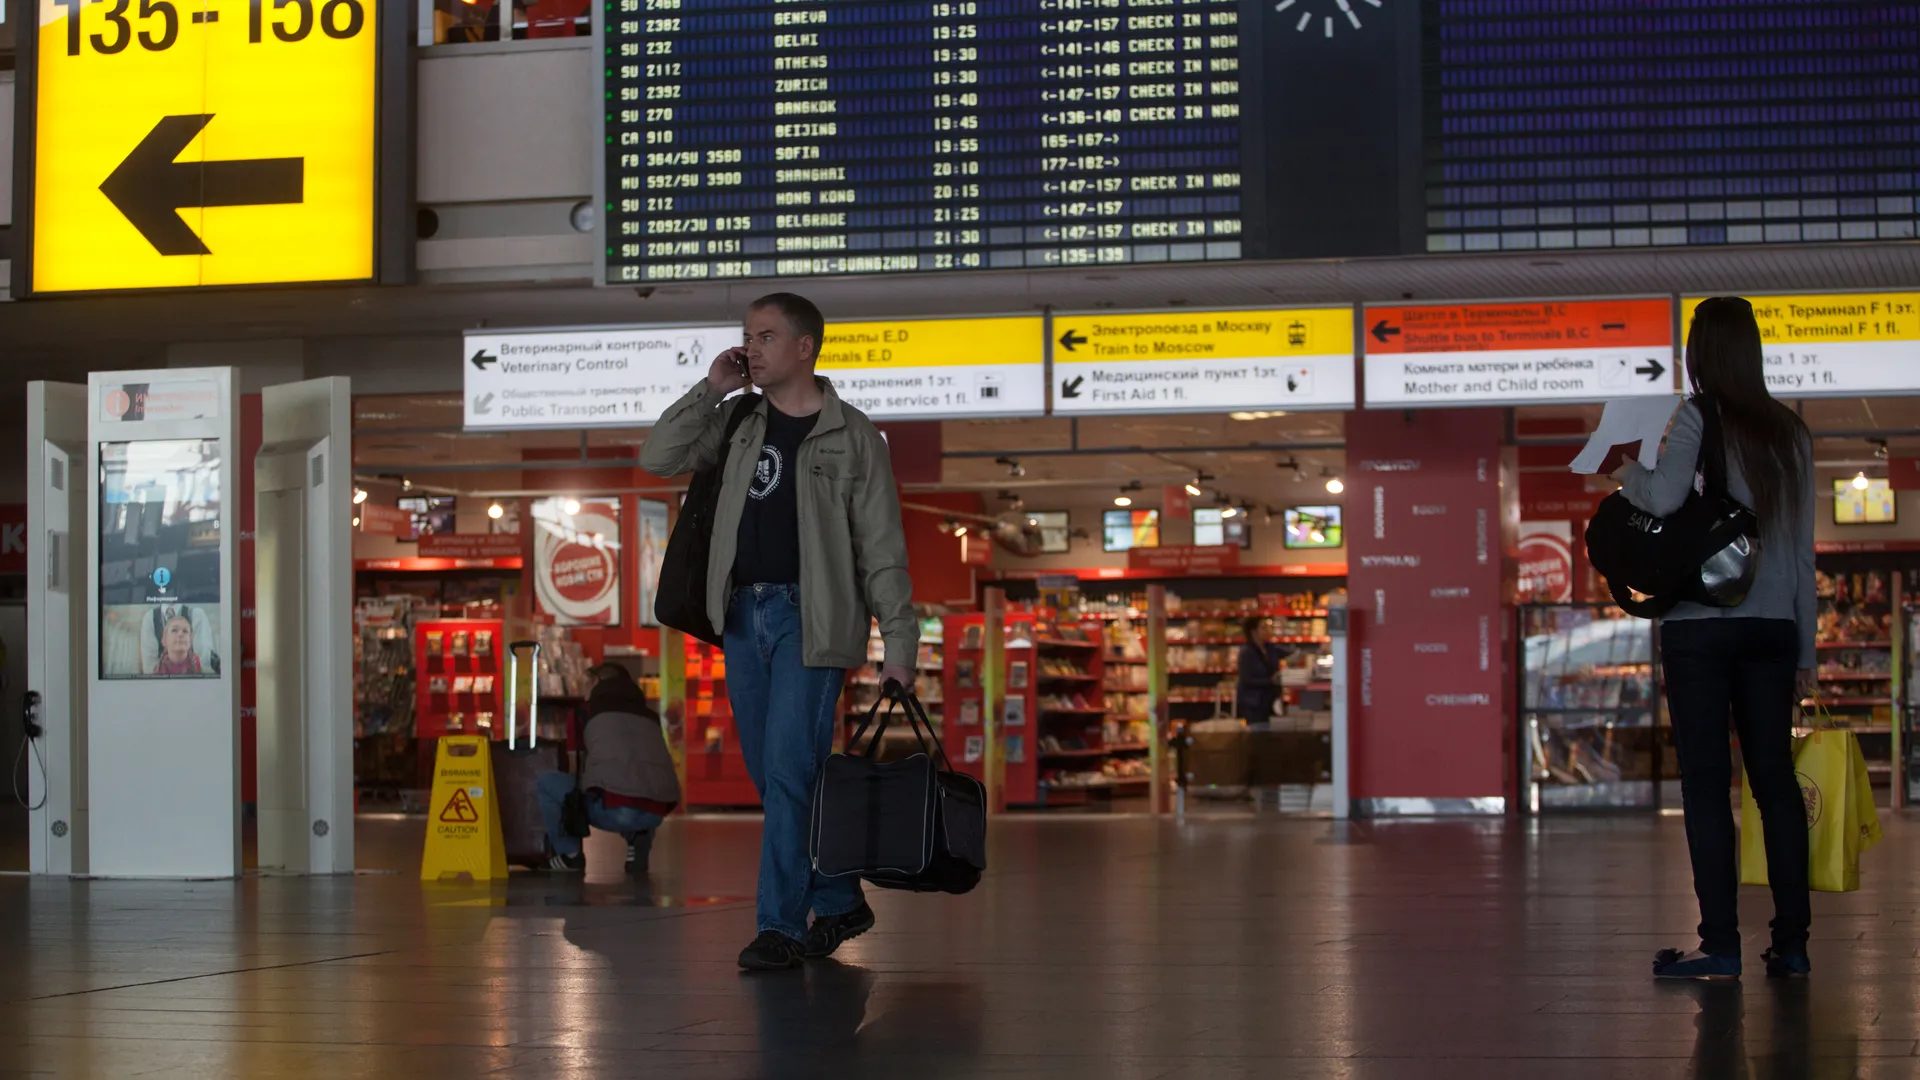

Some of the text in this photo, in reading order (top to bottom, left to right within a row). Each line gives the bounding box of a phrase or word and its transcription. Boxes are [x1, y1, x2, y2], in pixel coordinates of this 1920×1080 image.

[622, 22, 638, 34] SU
[774, 10, 826, 26] GENEVA
[934, 2, 976, 16] 19:10
[622, 44, 638, 56] SU
[774, 34, 818, 48] DELHI
[934, 24, 976, 40] 19:25
[1128, 16, 1174, 30] CHECK
[1184, 14, 1200, 26] IN
[1210, 12, 1238, 24] NOW
[620, 66, 638, 78] SU
[774, 56, 828, 70] ATHENS
[934, 48, 976, 62] 19:30
[1128, 38, 1174, 52] CHECK
[1184, 36, 1202, 50] IN
[1210, 36, 1238, 48] NOW
[622, 88, 638, 100] SU
[776, 78, 828, 92] ZURICH
[934, 70, 976, 84] 19:30
[1128, 60, 1174, 76] CHECK
[1184, 60, 1202, 72] IN
[1210, 58, 1238, 70] NOW
[622, 110, 638, 122] SU
[774, 100, 836, 116] BANGKOK
[934, 92, 978, 108] 19:40
[1130, 84, 1174, 98] CHECK
[1184, 82, 1202, 96] IN
[1210, 82, 1238, 94] NOW
[622, 132, 638, 146] CA
[776, 122, 836, 138] BEIJING
[934, 116, 978, 130] 19:45
[1130, 106, 1176, 122] CHECK
[1184, 106, 1202, 120] IN
[1212, 104, 1240, 118] NOW
[776, 146, 820, 160] SOFIA
[936, 138, 978, 152] 19:55
[622, 176, 638, 190] MU
[776, 168, 844, 182] SHANGHAI
[934, 162, 978, 176] 20:10
[622, 200, 640, 212] SU
[776, 192, 810, 204] HONG
[820, 190, 856, 204] KONG
[934, 184, 978, 198] 20:15
[1130, 176, 1176, 190] CHECK
[1186, 174, 1204, 188] IN
[1212, 174, 1240, 186] NOW
[622, 222, 640, 234] SU
[776, 212, 846, 228] BELGRADE
[934, 208, 980, 222] 21:25
[622, 244, 638, 256] SU
[776, 236, 846, 250] SHANGHAI
[934, 230, 980, 244] 21:30
[1132, 222, 1178, 236] CHECK
[1188, 222, 1204, 234] IN
[1214, 220, 1240, 234] NOW
[622, 266, 638, 280] CZ
[936, 254, 980, 268] 22:40
[1789, 302, 1880, 320] Терминал F
[1092, 324, 1198, 338] Электропоезд
[1216, 320, 1272, 334] Москву
[1404, 330, 1449, 344] Shuttle
[1454, 330, 1477, 342] bus
[1482, 330, 1494, 342] to
[1499, 328, 1562, 340] Terminals
[1785, 322, 1853, 338] Terminal
[1859, 322, 1868, 334] F
[500, 339, 672, 356] Ветеринарный контроль
[1094, 341, 1215, 356] Train to Moscow
[501, 358, 628, 374] Veterinary Control
[1404, 359, 1594, 375] Комната матери и ребёнка
[850, 377, 922, 391] хранения
[1092, 368, 1248, 383] Медицинский пункт
[591, 385, 646, 398] транспорт
[1092, 388, 1127, 401] First
[1130, 387, 1156, 400] Aid
[1405, 378, 1584, 394] Mother and Child room
[887, 394, 938, 406] service
[502, 404, 544, 417] Public
[550, 402, 618, 417] Transport
